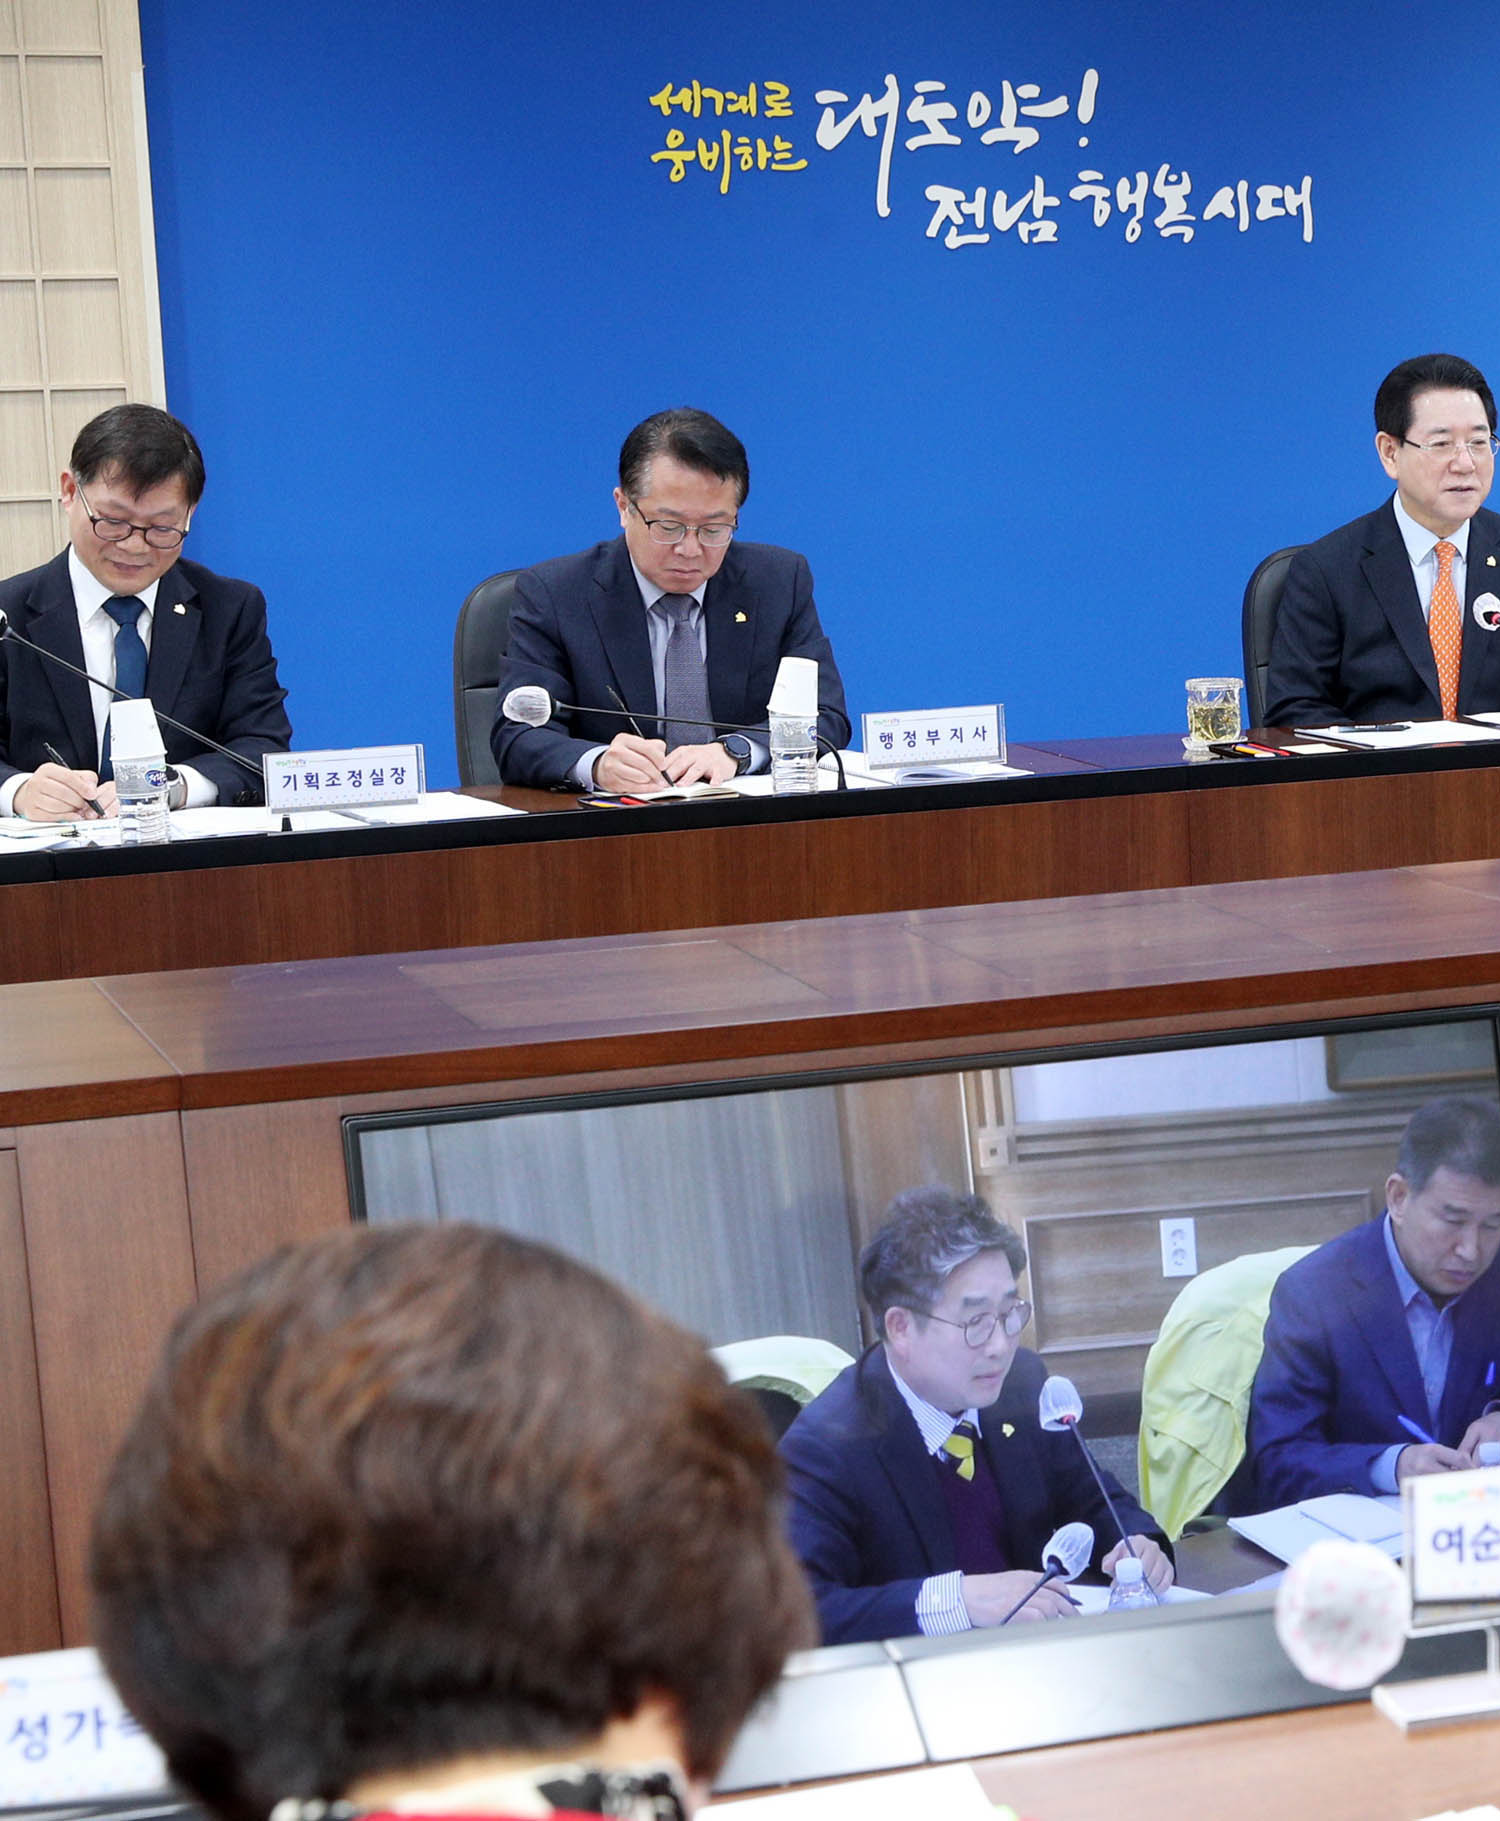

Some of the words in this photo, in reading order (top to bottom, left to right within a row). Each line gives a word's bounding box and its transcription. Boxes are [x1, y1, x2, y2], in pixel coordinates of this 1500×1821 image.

[649, 80, 794, 119] 세계로
[650, 129, 808, 194] 웅비하는
[815, 67, 1099, 217] 대도약!
[926, 174, 1061, 248] 전남
[1069, 163, 1196, 243] 행복
[1202, 175, 1313, 243] 시대
[879, 725, 988, 750] 행정부지사
[282, 767, 407, 791] 기획조정실장
